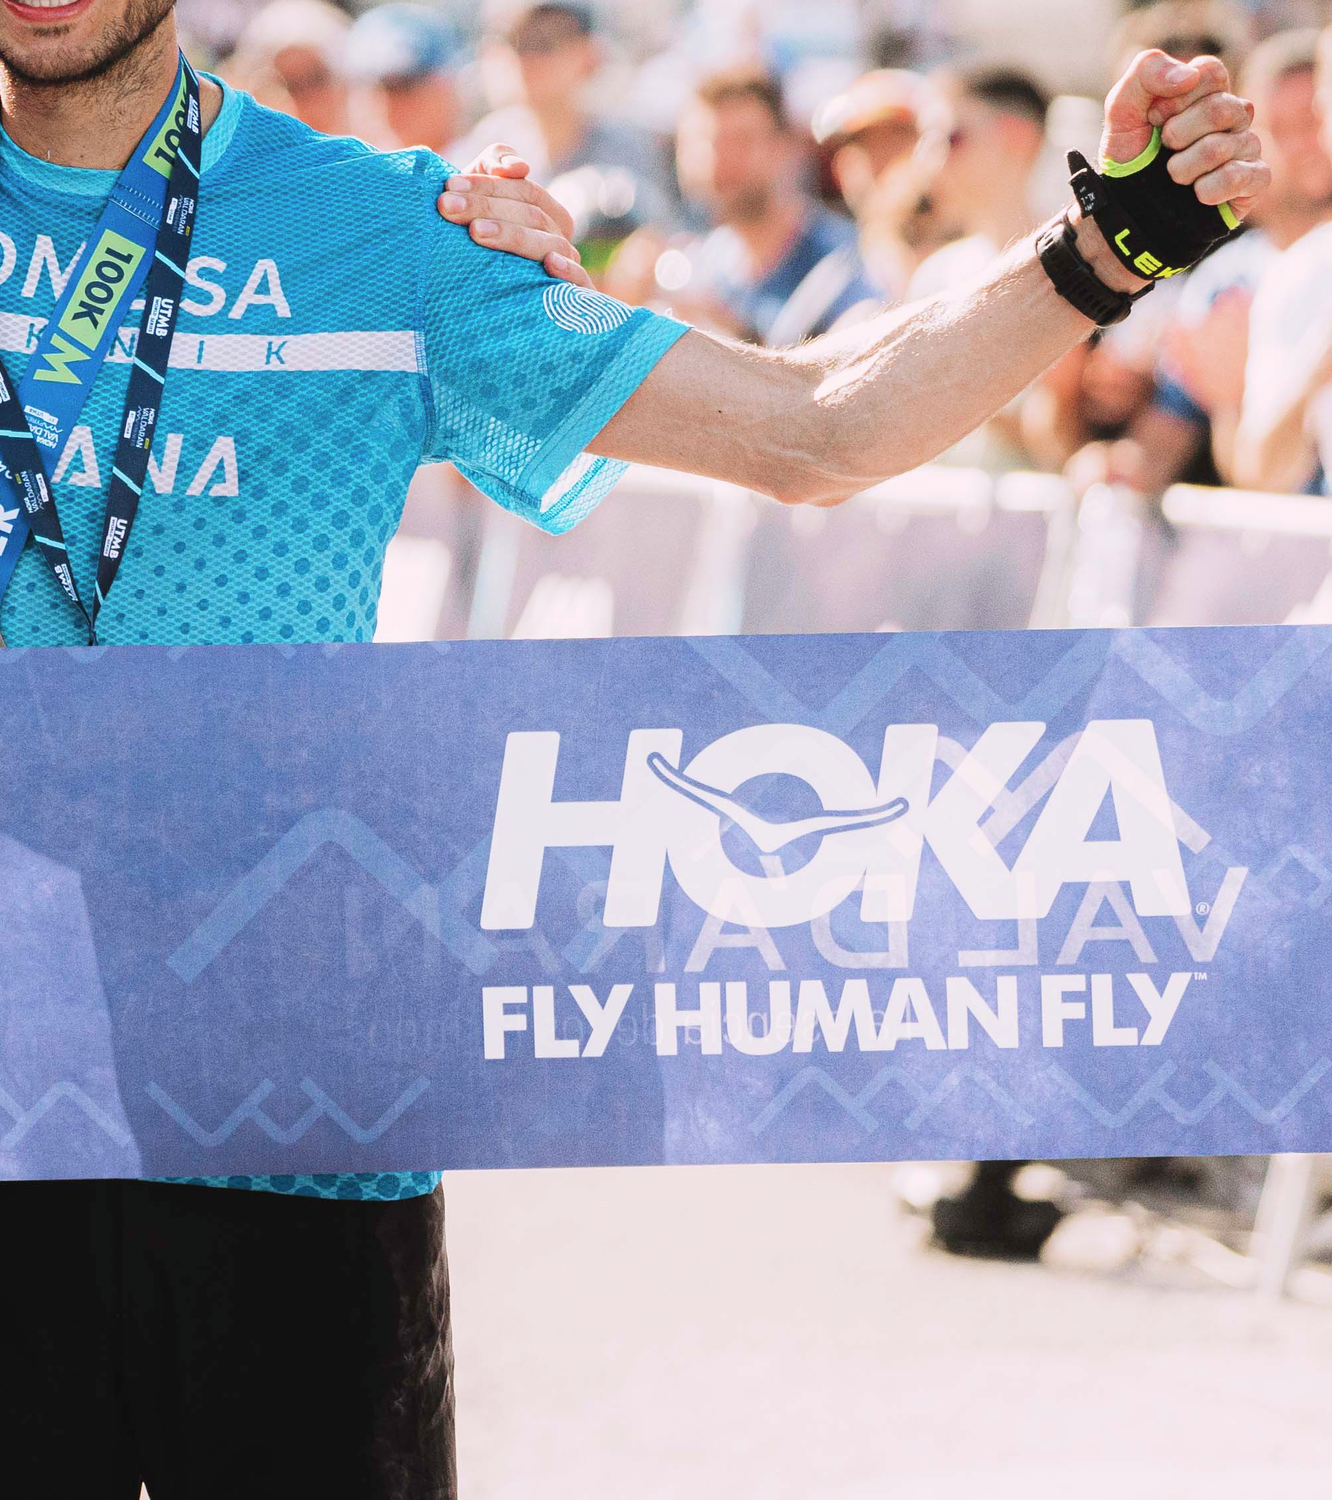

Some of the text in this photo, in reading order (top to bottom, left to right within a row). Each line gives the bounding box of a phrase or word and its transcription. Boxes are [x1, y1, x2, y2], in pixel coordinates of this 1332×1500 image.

[33, 246, 134, 385] 100K M
[156, 298, 174, 338] UTMB
[110, 518, 128, 560] UTMB
[482, 983, 634, 1060] FLY
[654, 975, 1019, 1058] HUMAN
